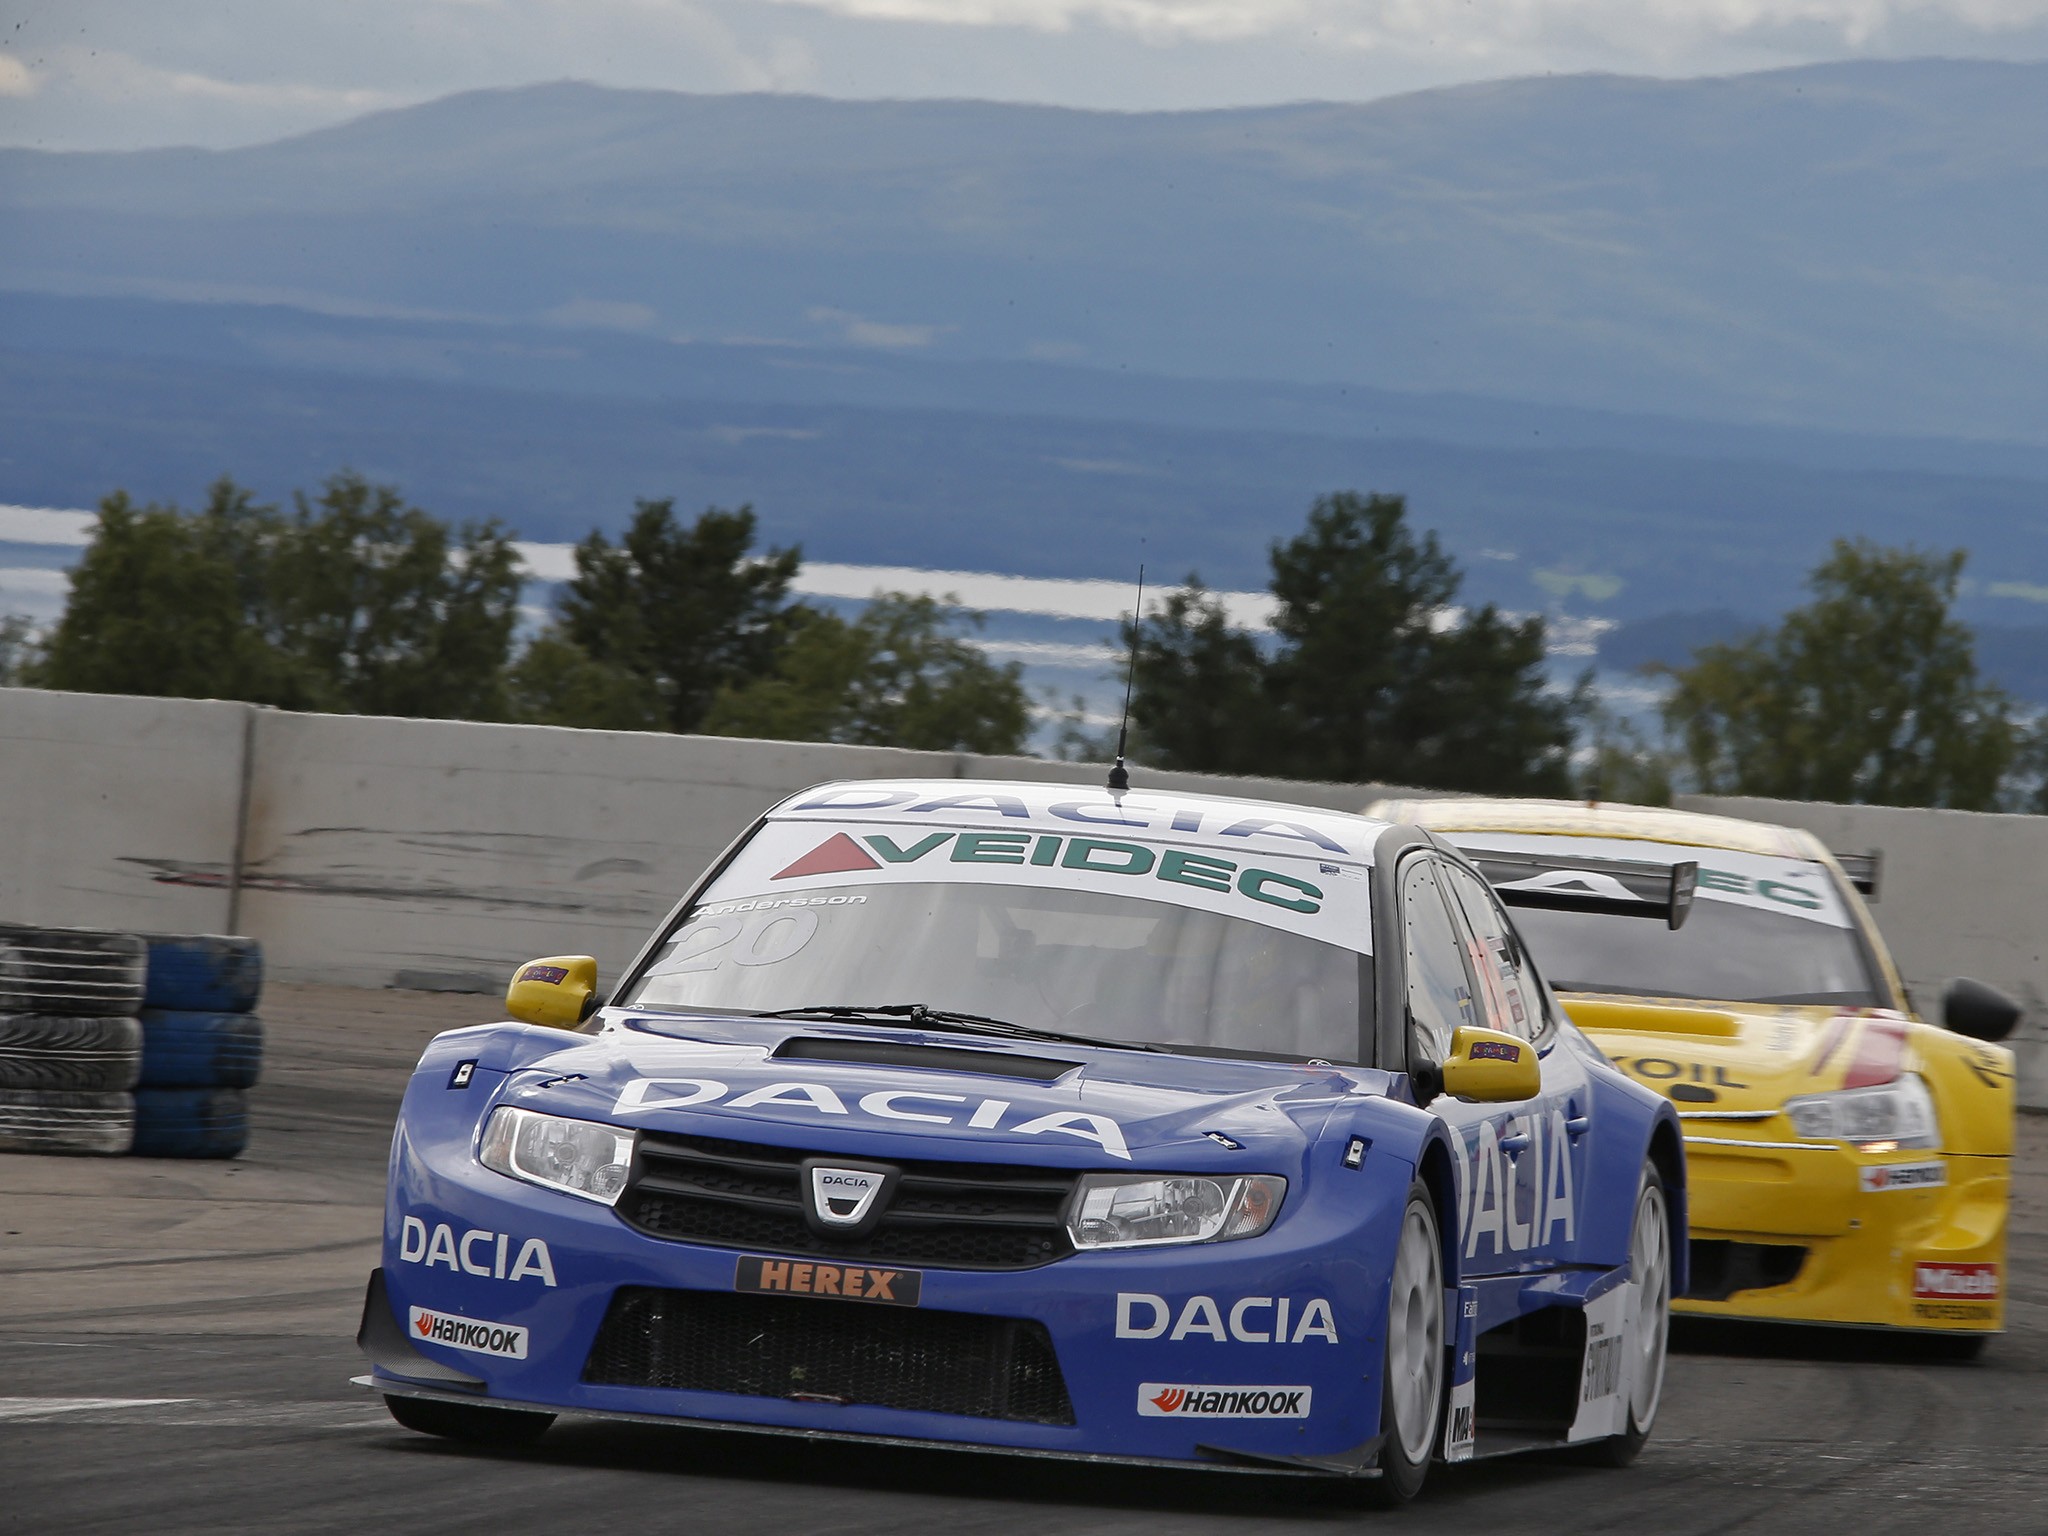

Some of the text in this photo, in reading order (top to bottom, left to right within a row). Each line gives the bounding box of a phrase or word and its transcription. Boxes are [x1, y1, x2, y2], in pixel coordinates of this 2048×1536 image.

[789, 791, 1350, 855] DACIA
[861, 832, 1324, 914] VEIDEC
[689, 895, 868, 919] Andersson
[643, 908, 820, 977] 20
[611, 1078, 1132, 1161] DACIA
[822, 1175, 869, 1189] DACIA
[400, 1215, 558, 1287] DACIA
[760, 1261, 896, 1300] HEREX
[1115, 1292, 1339, 1344] DACIA
